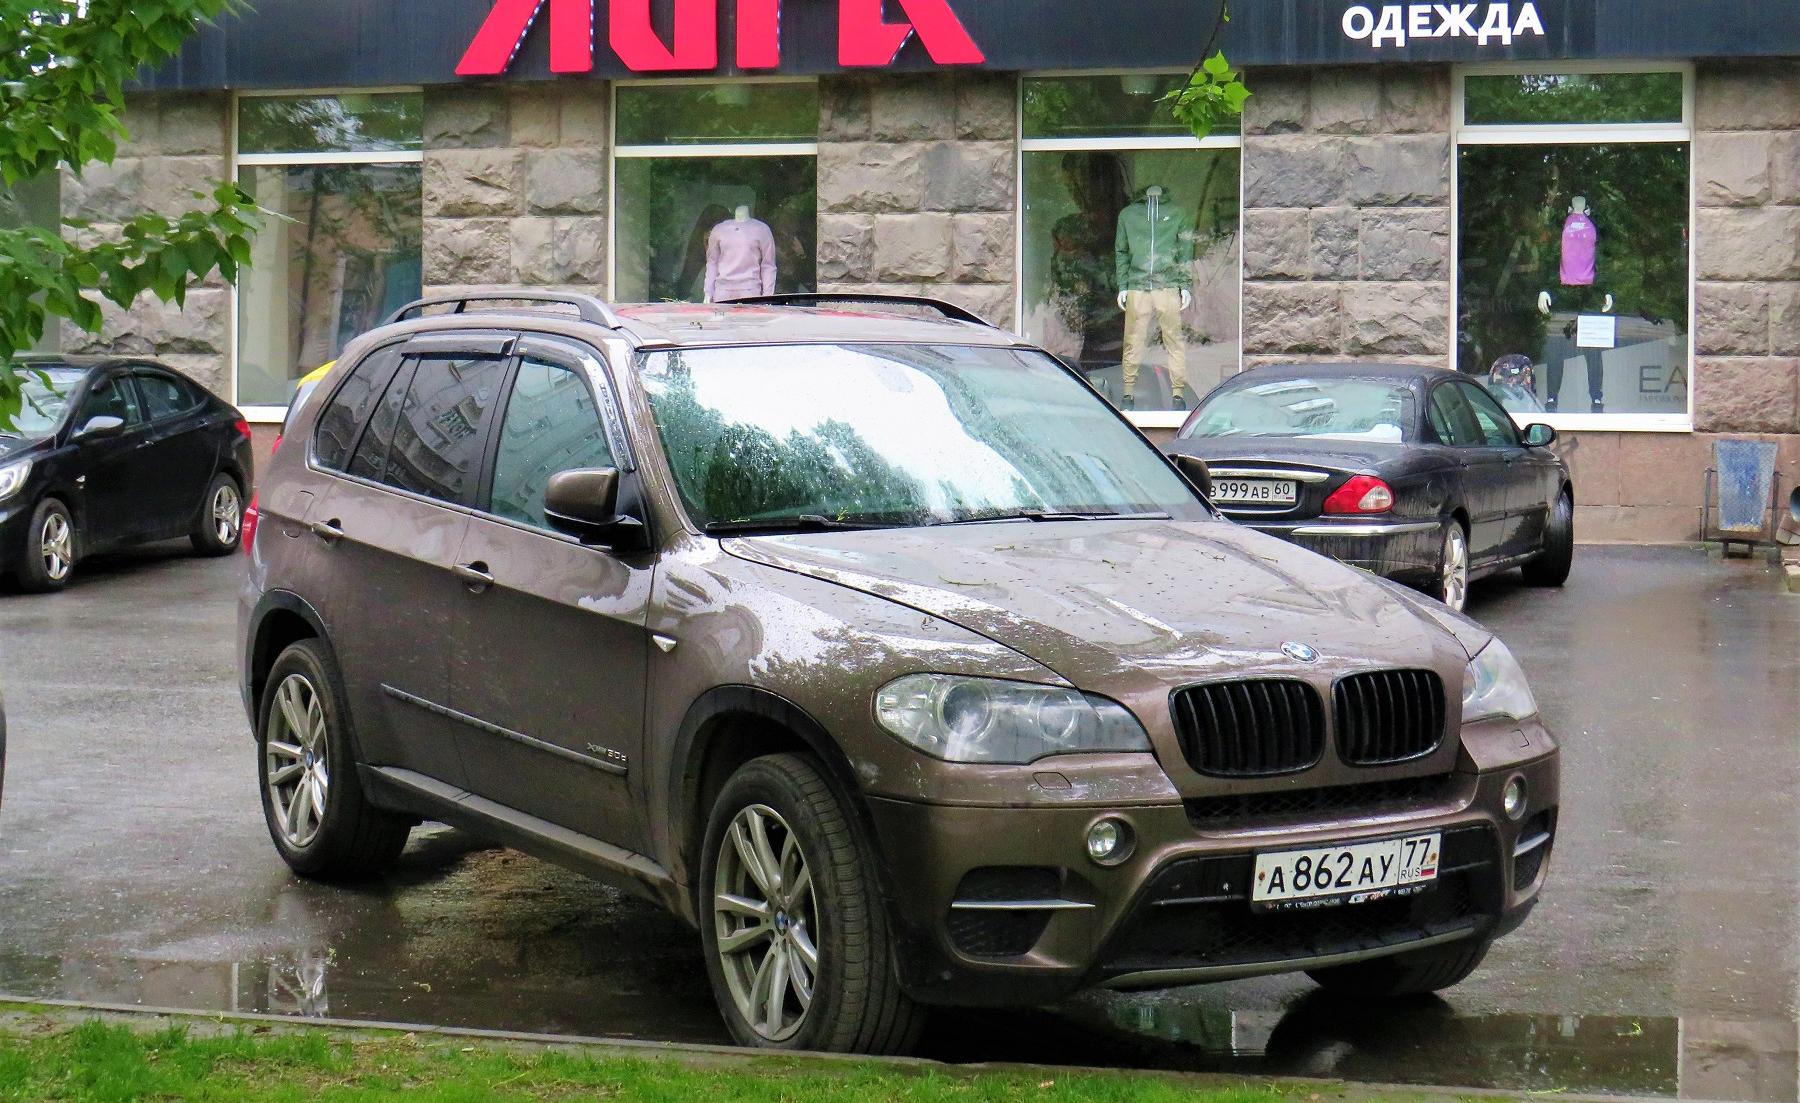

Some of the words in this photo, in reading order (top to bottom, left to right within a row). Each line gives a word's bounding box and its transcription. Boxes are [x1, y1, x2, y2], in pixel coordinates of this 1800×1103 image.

[1341, 2, 1545, 47] ОДЕЖДА
[1639, 365, 1688, 393] EA
[1274, 482, 1290, 495] 60
[1405, 838, 1431, 868] 77
[1400, 867, 1421, 880] RUS
